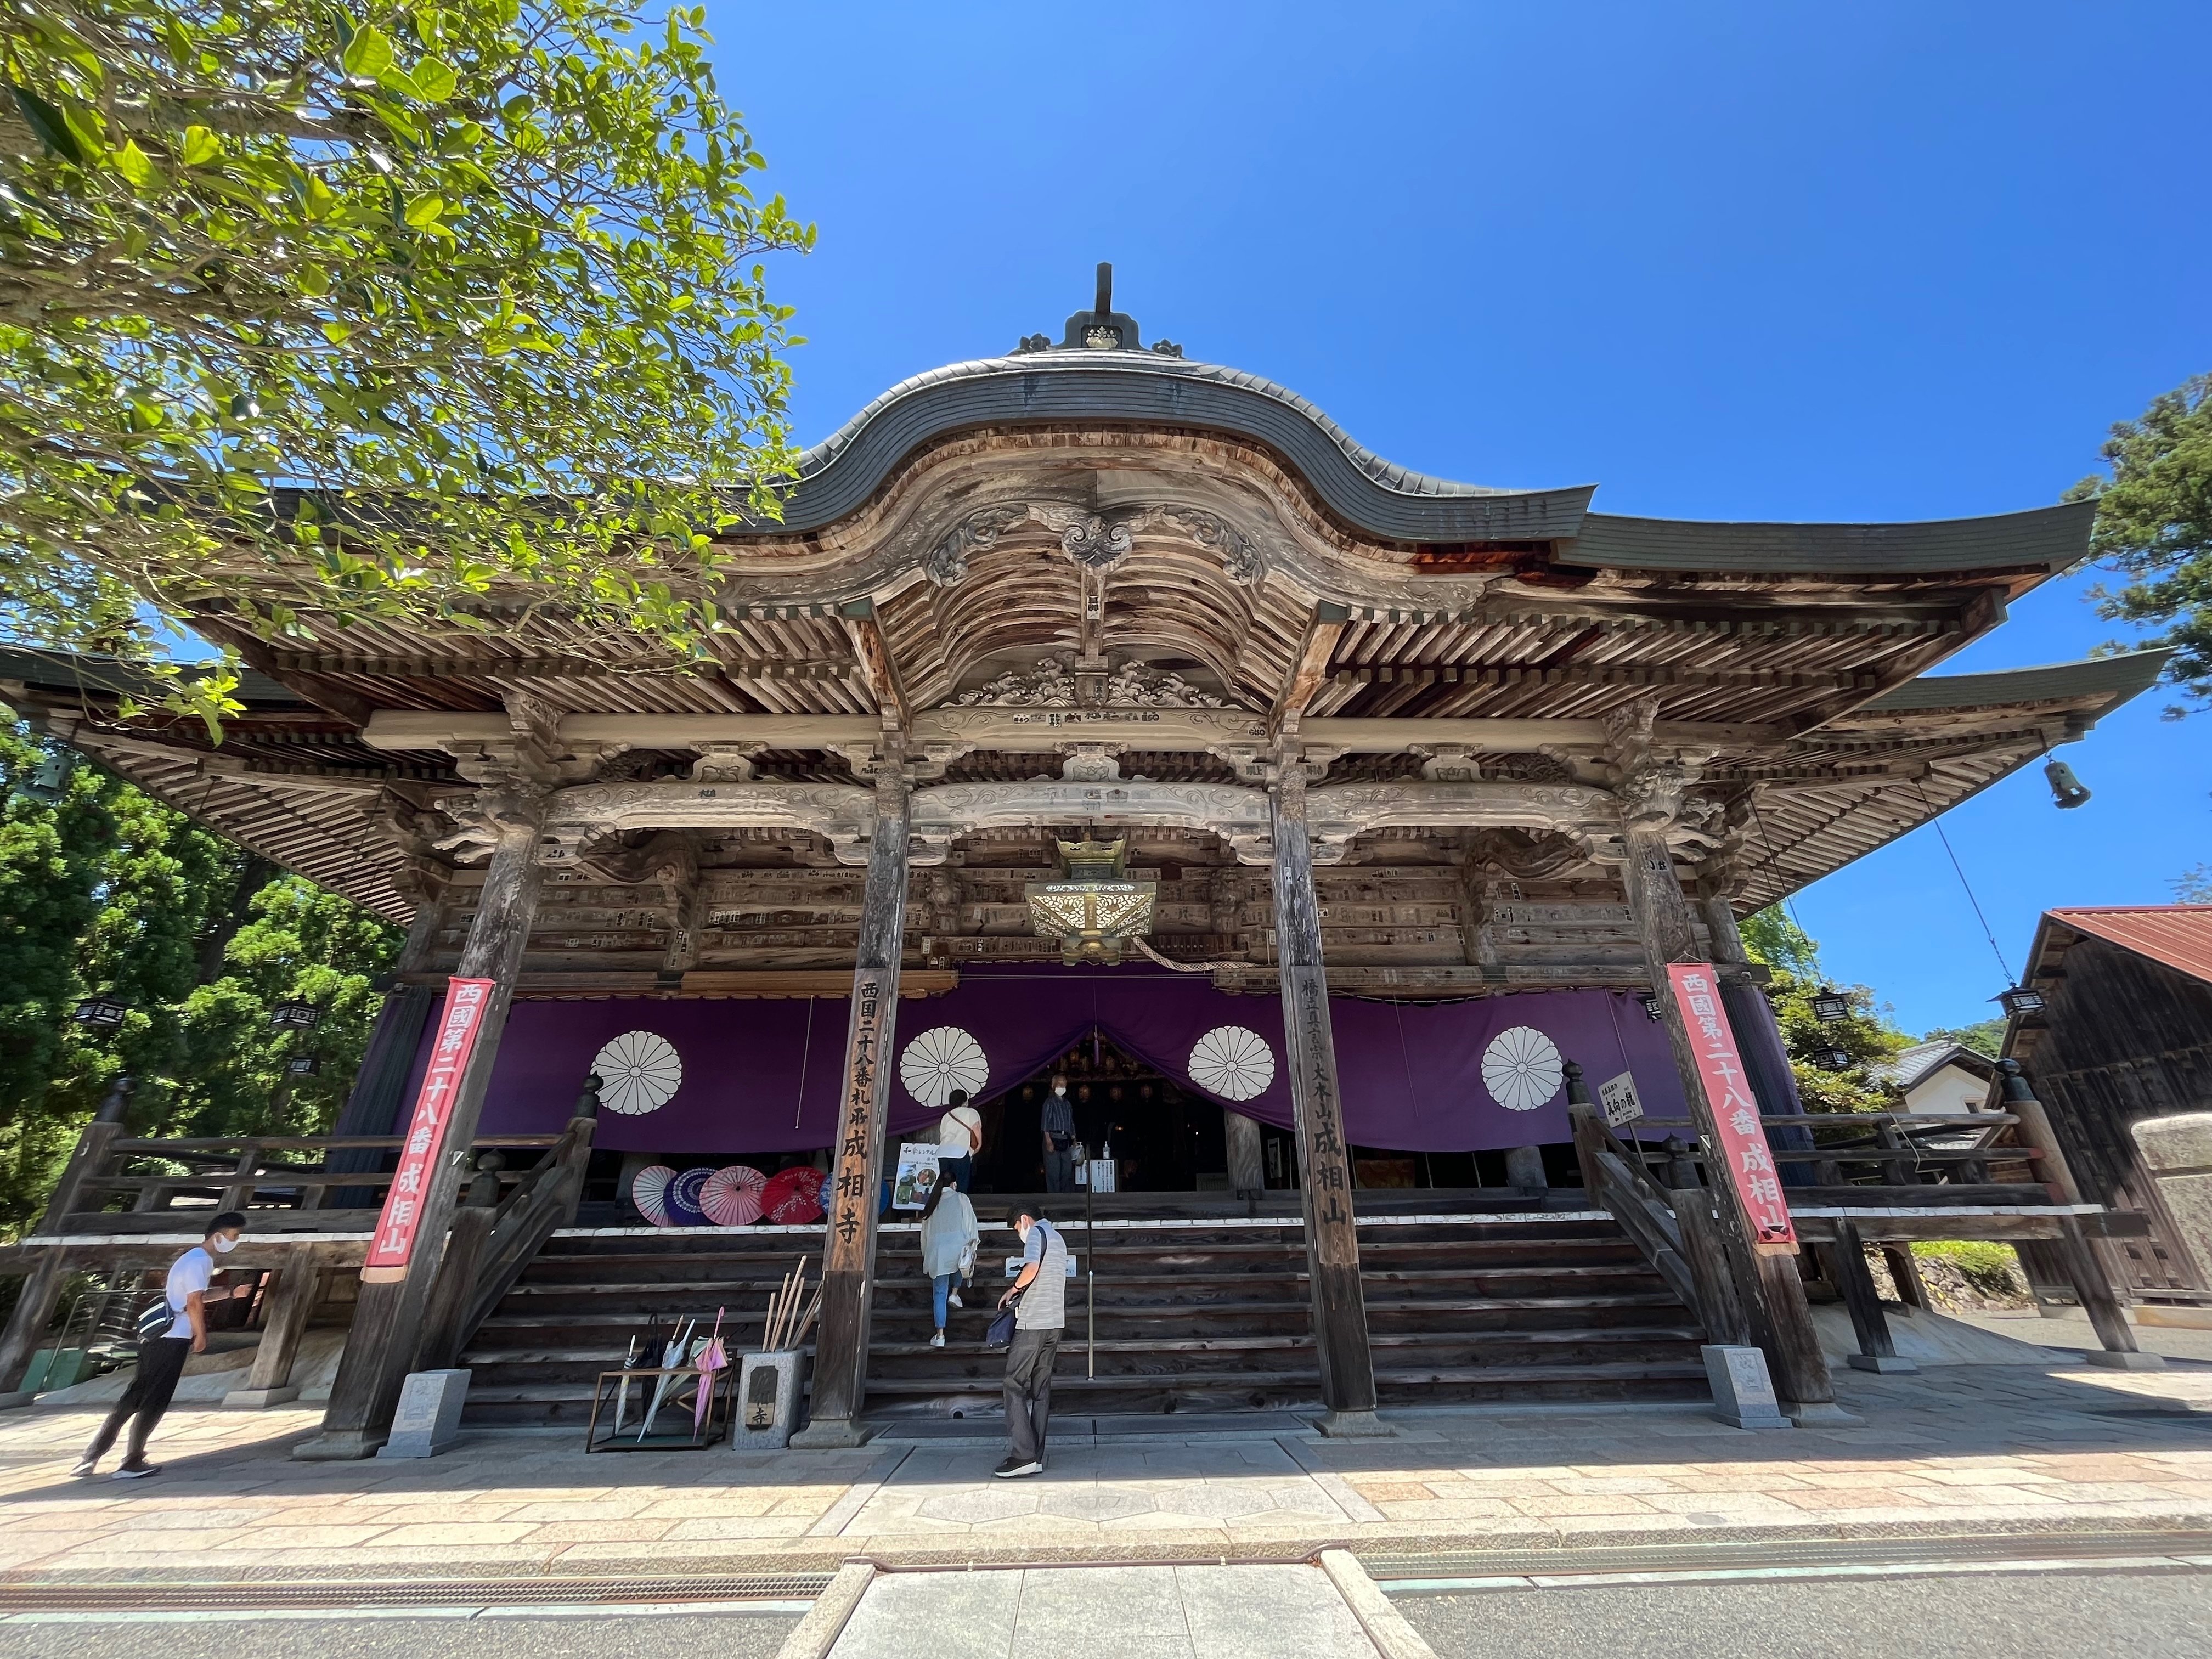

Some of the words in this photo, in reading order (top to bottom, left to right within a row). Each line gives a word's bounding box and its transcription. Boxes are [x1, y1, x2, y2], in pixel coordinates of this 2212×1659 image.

[380, 983, 482, 1255] 西國第二十八番成相山
[835, 982, 879, 1244] 西国二十八番札所成相寺
